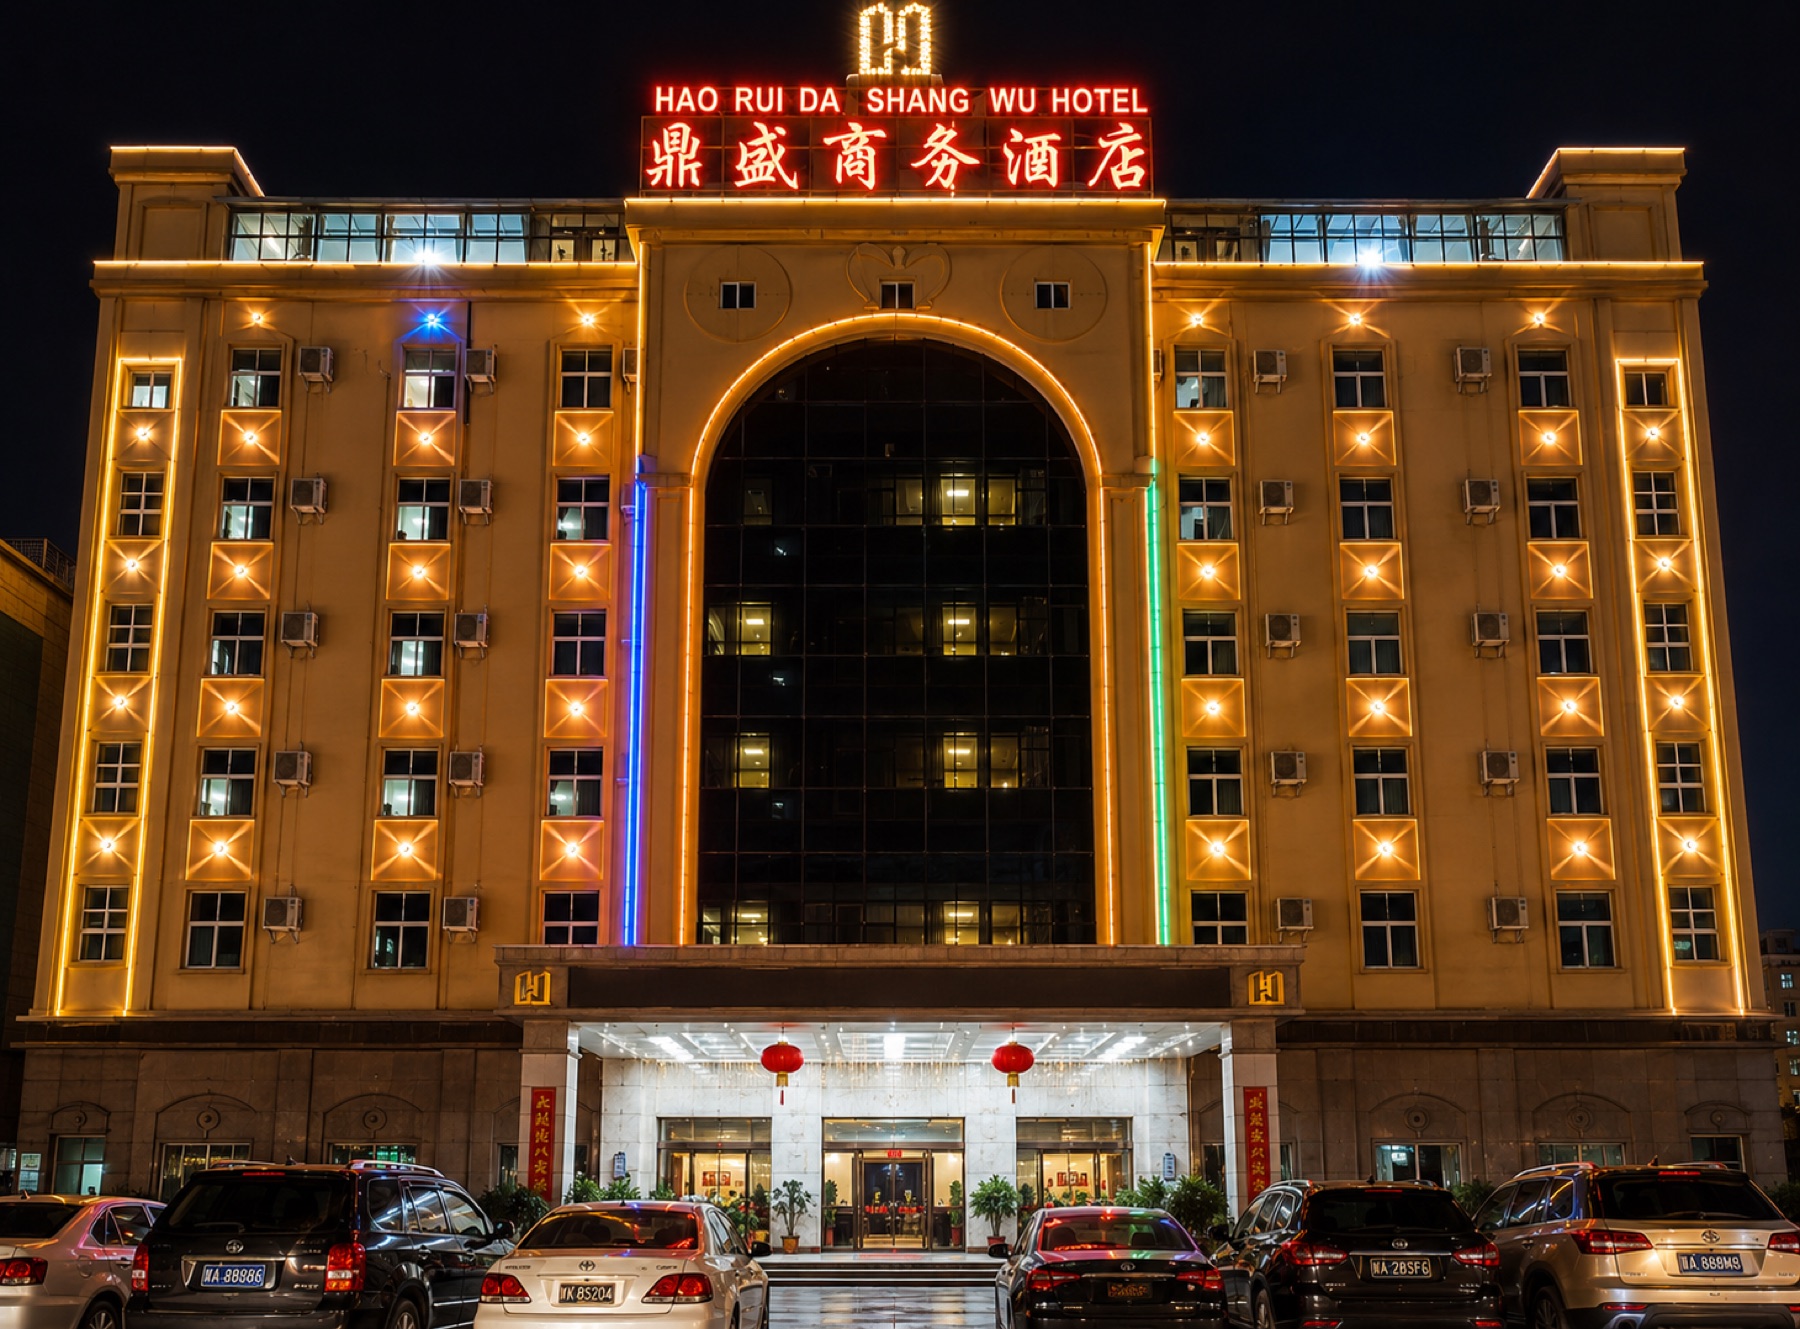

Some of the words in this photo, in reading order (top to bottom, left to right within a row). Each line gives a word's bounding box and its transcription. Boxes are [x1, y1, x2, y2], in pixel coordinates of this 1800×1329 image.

[655, 86, 719, 112] HAO
[735, 86, 783, 112] RUI
[800, 86, 841, 112] DA
[867, 87, 969, 113] SHANG
[989, 87, 1036, 113] WU
[1052, 87, 1148, 113] HOTEL
[646, 121, 1146, 190] 鼎盛商务酒店
